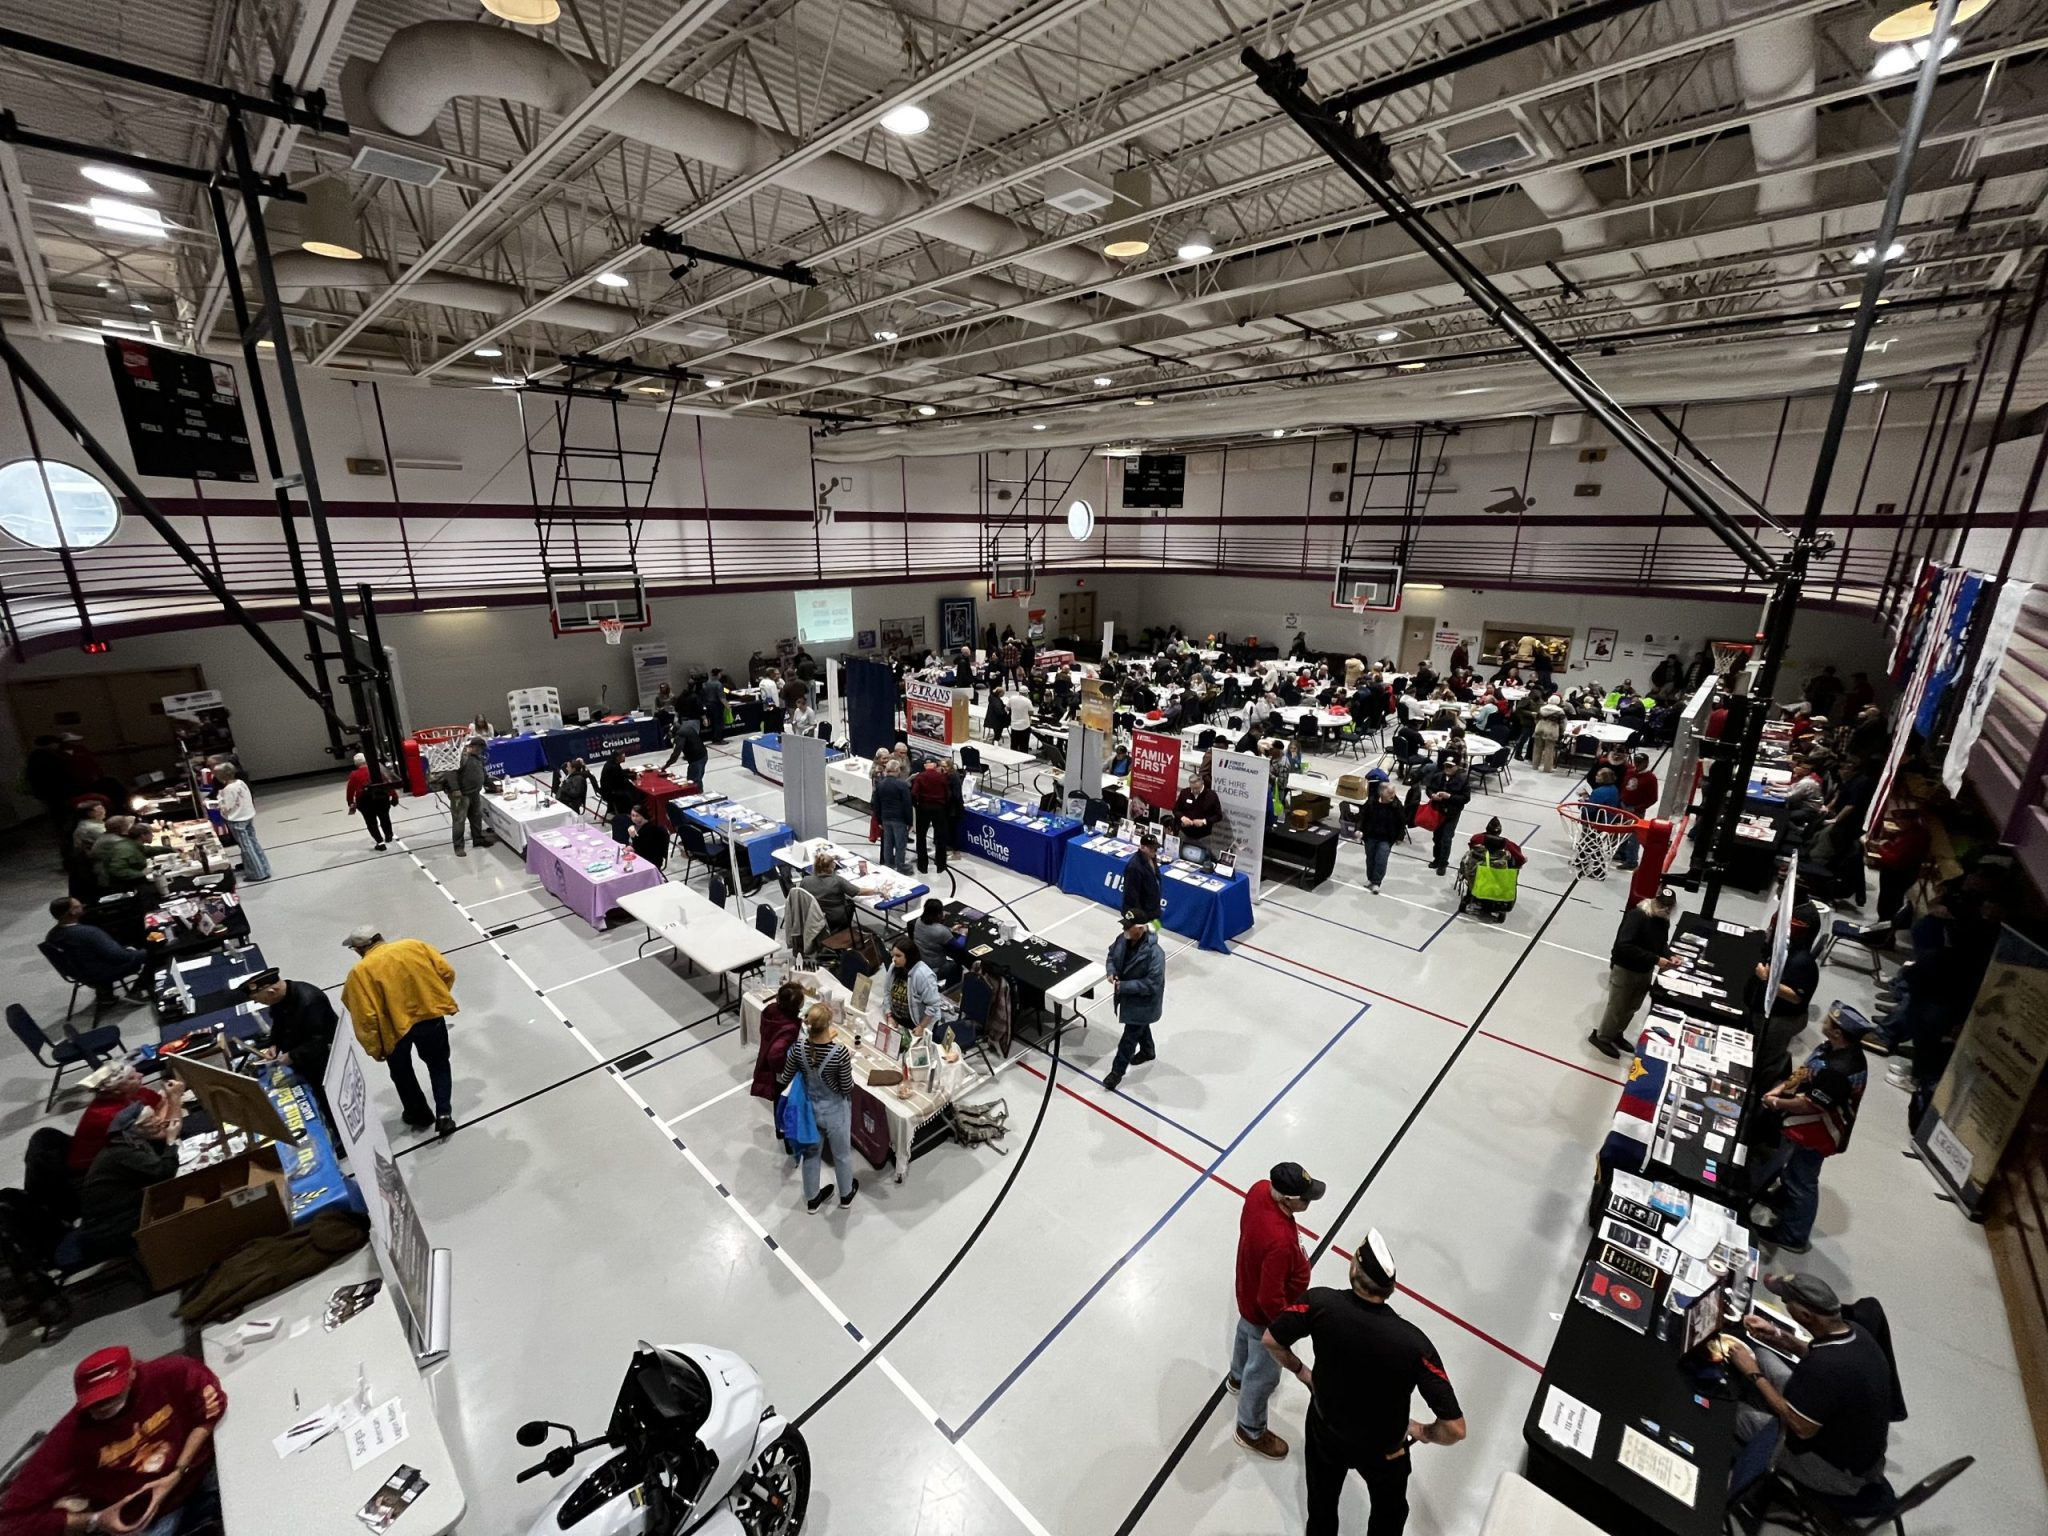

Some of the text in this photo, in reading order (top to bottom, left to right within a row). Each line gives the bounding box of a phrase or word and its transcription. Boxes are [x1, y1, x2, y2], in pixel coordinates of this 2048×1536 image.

[134, 378, 160, 391] HOME
[212, 393, 235, 406] GUEST
[602, 736, 641, 749] Crisis Line
[1135, 746, 1174, 765] FAMILY
[1134, 757, 1167, 775] FIRST
[1213, 785, 1250, 799] LEADERS
[1214, 777, 1248, 791] WE HIRE
[967, 830, 1010, 857] helpline
[986, 849, 1009, 862] center
[300, 1100, 316, 1121] MARCH
[1577, 1406, 1588, 1431] American
[354, 1428, 366, 1457] Sturgis
